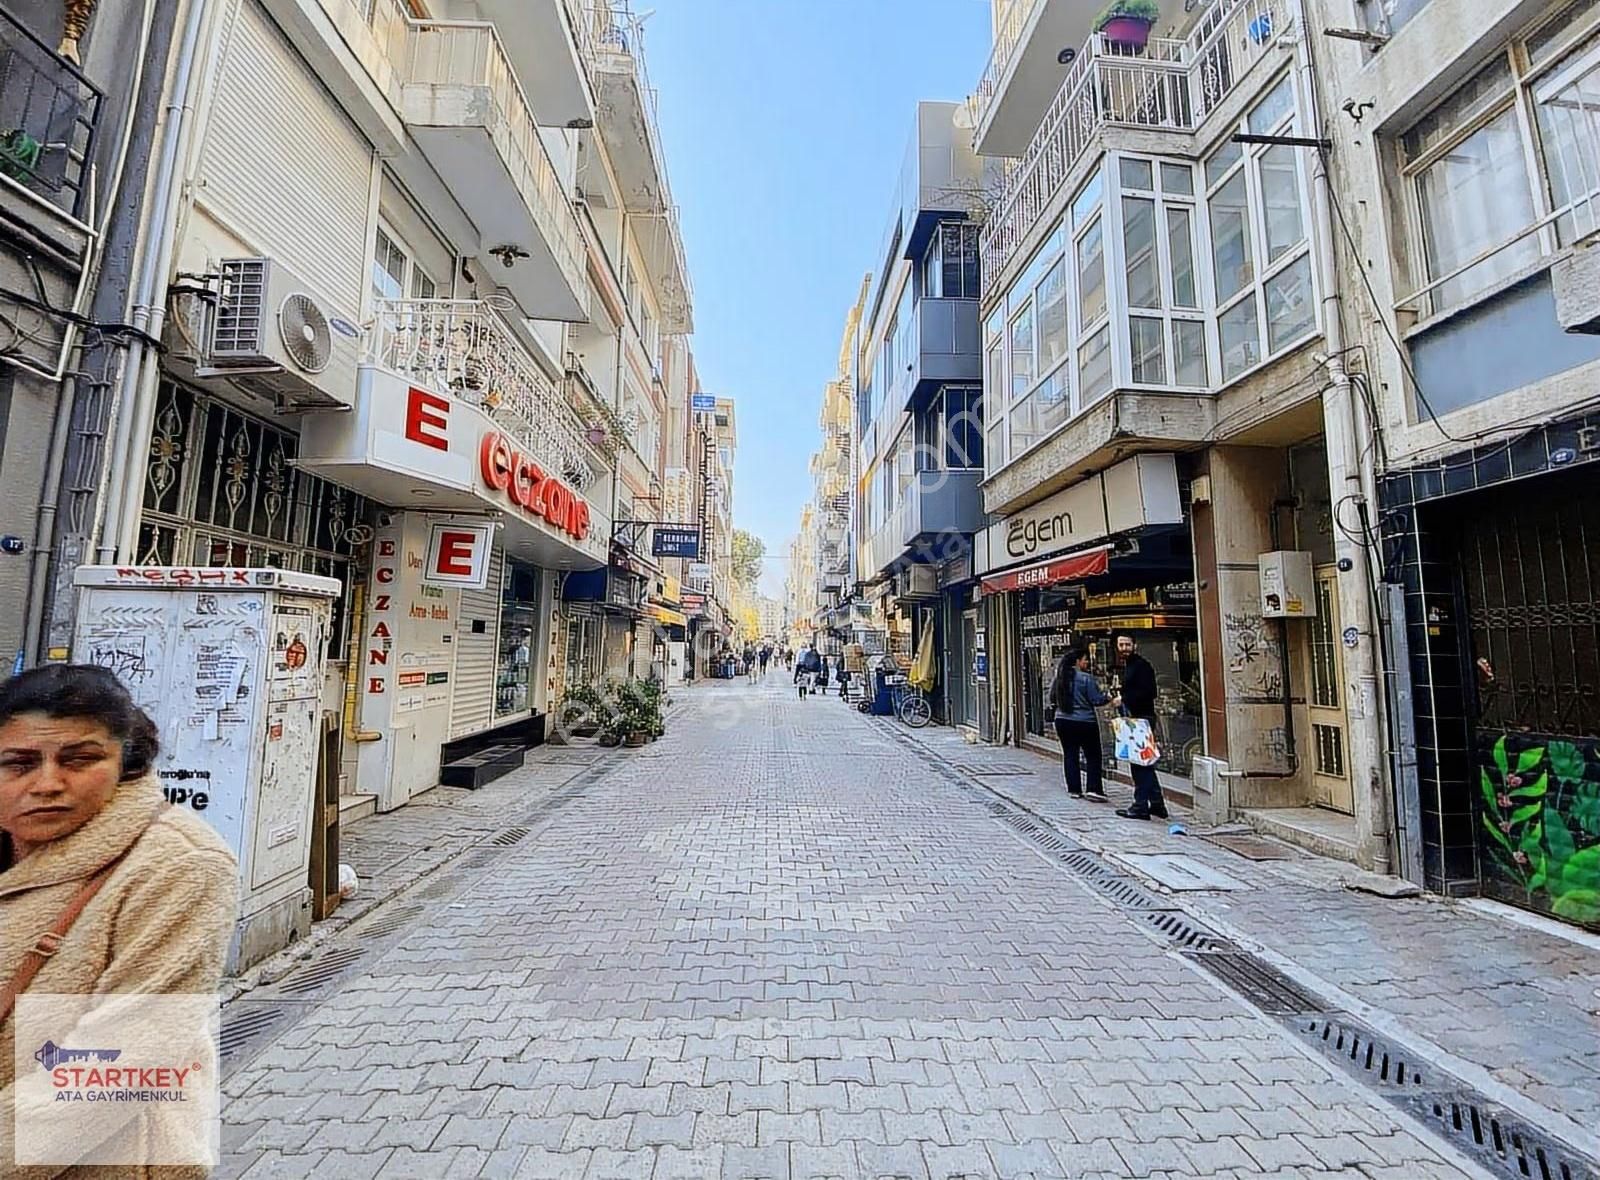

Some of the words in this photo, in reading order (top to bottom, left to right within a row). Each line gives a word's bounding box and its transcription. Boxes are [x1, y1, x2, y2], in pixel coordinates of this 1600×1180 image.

[406, 386, 450, 451] E
[480, 431, 592, 540] eczane
[437, 531, 476, 576] E
[1007, 512, 1073, 558] Egem
[1017, 566, 1049, 587] EGEM
[368, 539, 396, 694] ECZANE
